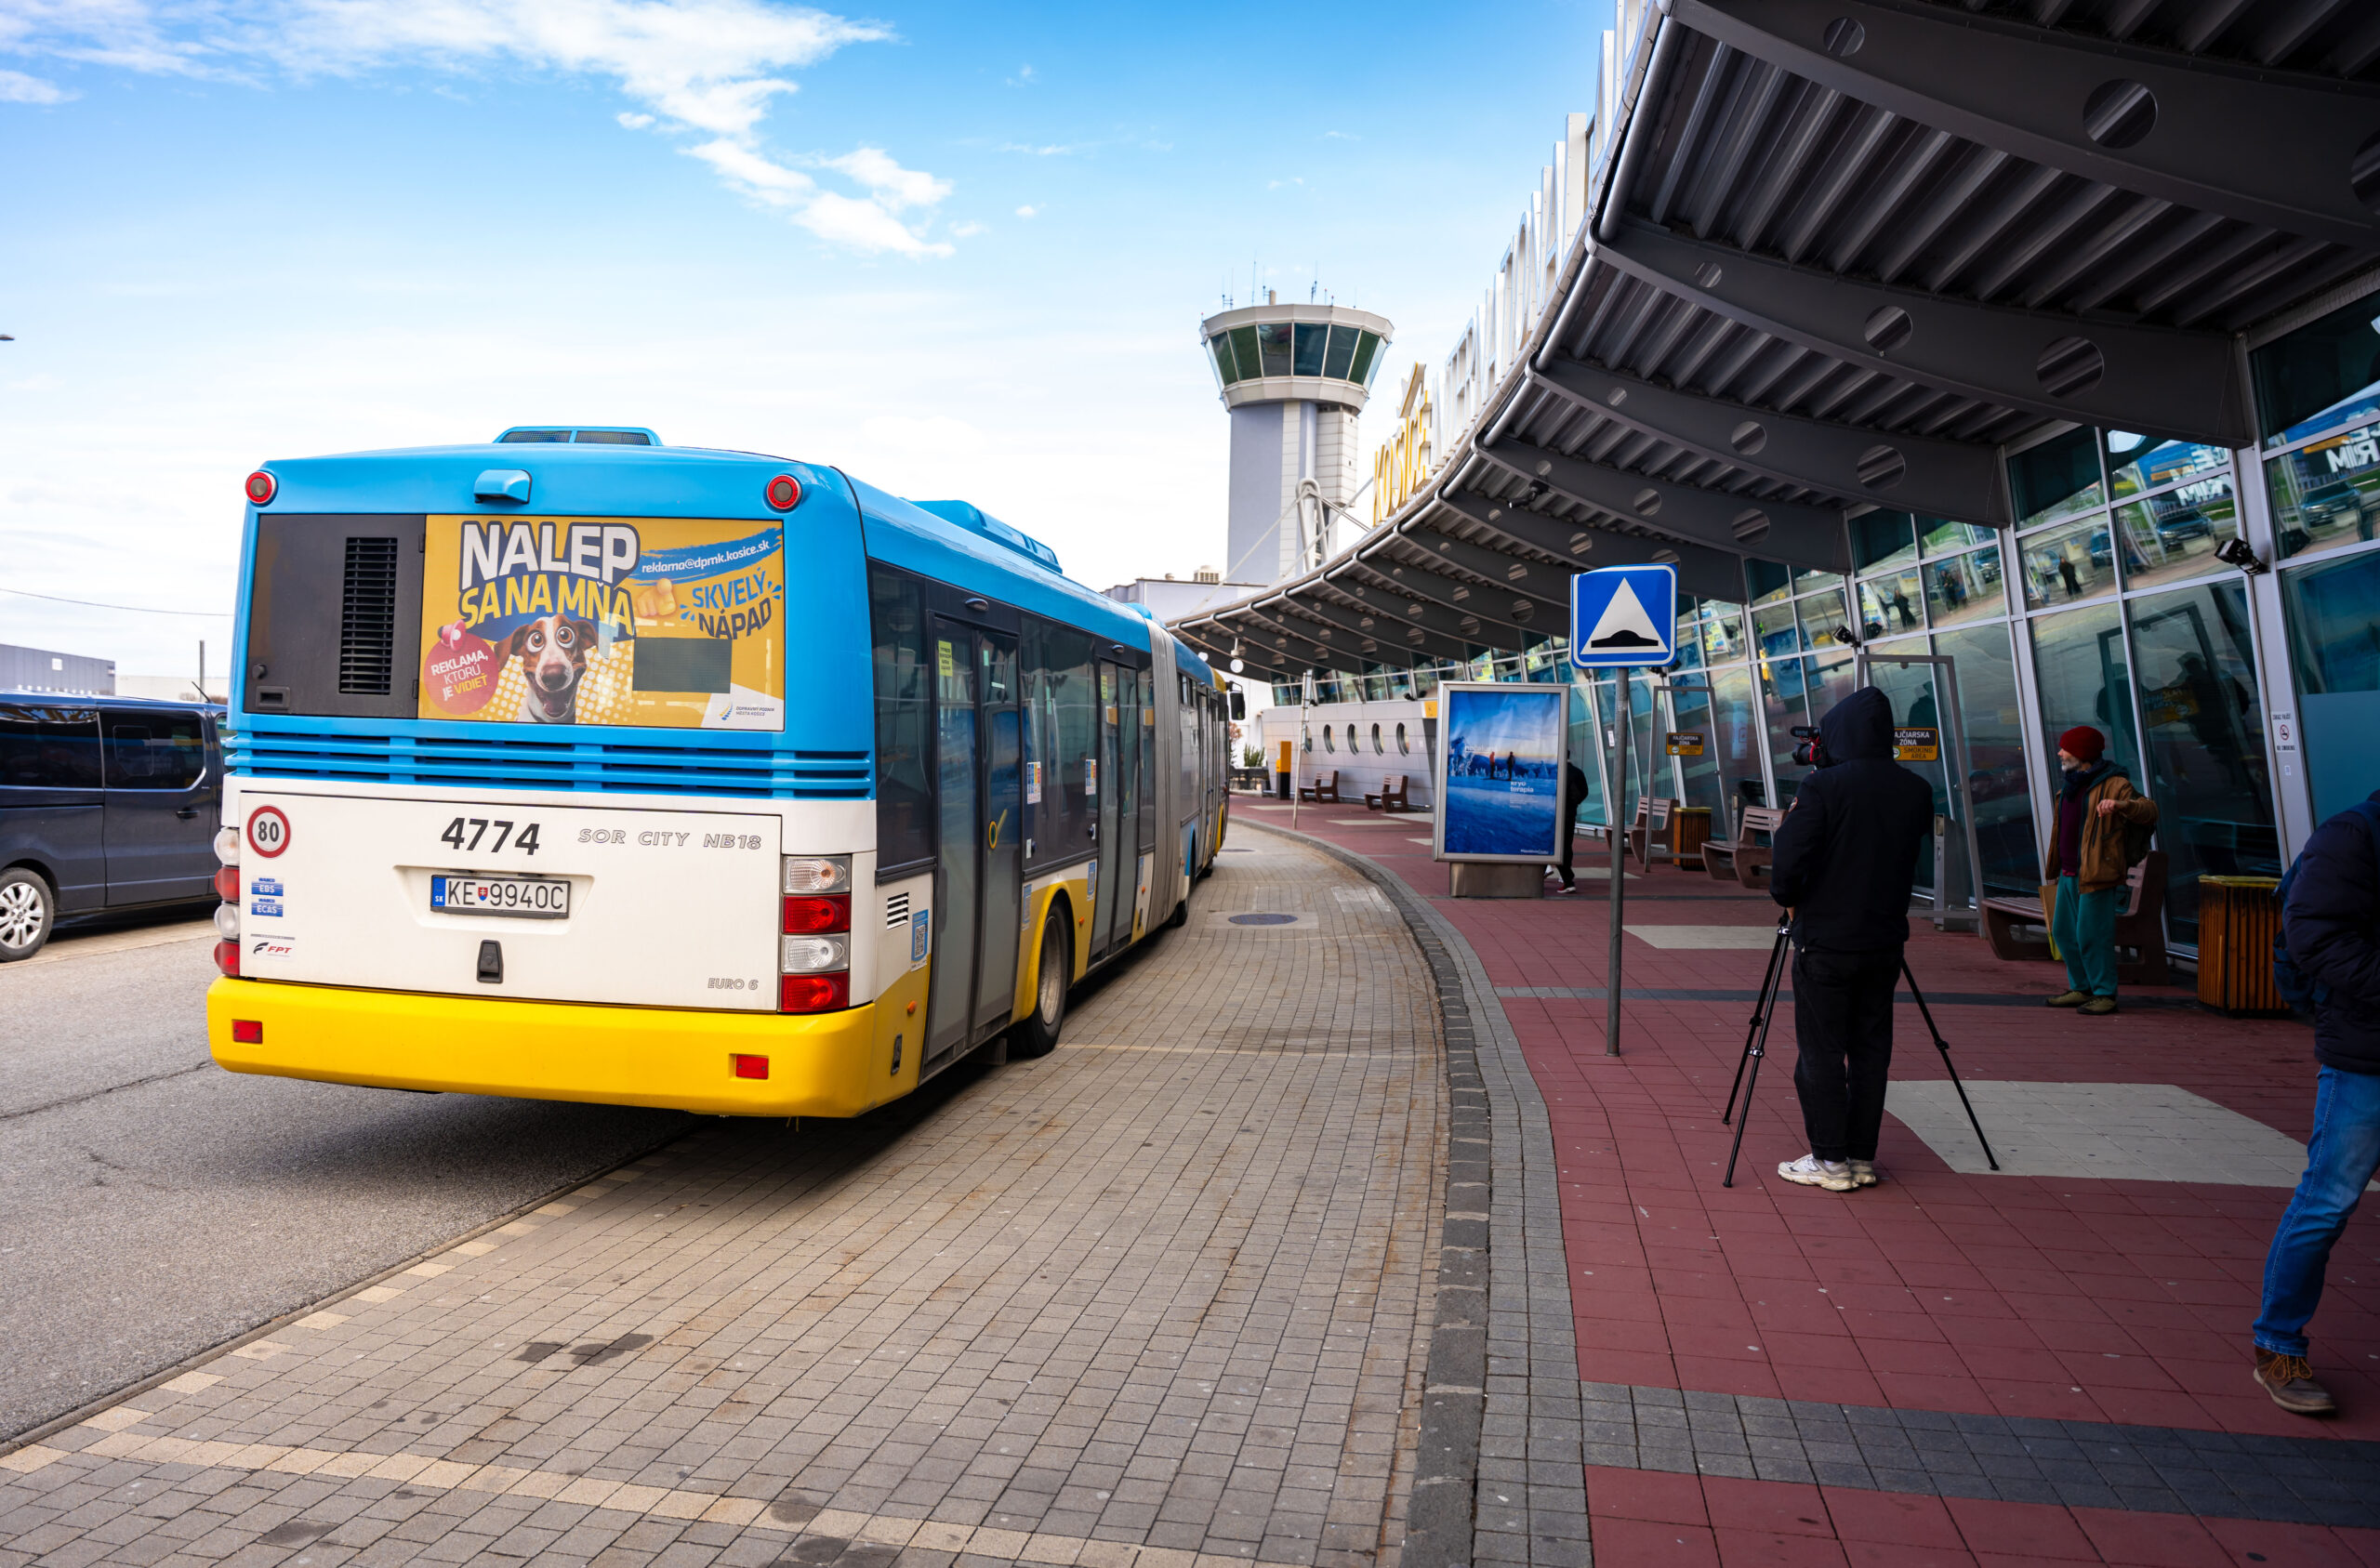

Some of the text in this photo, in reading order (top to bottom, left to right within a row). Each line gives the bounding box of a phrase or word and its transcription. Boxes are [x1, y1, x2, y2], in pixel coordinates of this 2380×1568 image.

[461, 523, 638, 590] NALEP
[641, 540, 770, 573] reklama@dpmk.kosice.sk
[692, 567, 766, 609] SKVELÝ
[461, 574, 634, 636] SA NA MŇA
[699, 598, 772, 639] NÁPAD
[431, 650, 489, 676] REKLAMA,
[443, 662, 482, 685] KTORÚ
[443, 673, 488, 702] JE VIDIEŤ
[1899, 738, 1917, 746] ZÓNA
[1510, 785, 1534, 794] terapia
[258, 821, 280, 842] 80
[441, 817, 540, 855] 4774
[577, 828, 762, 850] SOR CITY NB18
[258, 884, 275, 893] EBS
[447, 880, 476, 905] KE
[256, 904, 277, 915] ECAS
[707, 978, 760, 991] EURO 6
